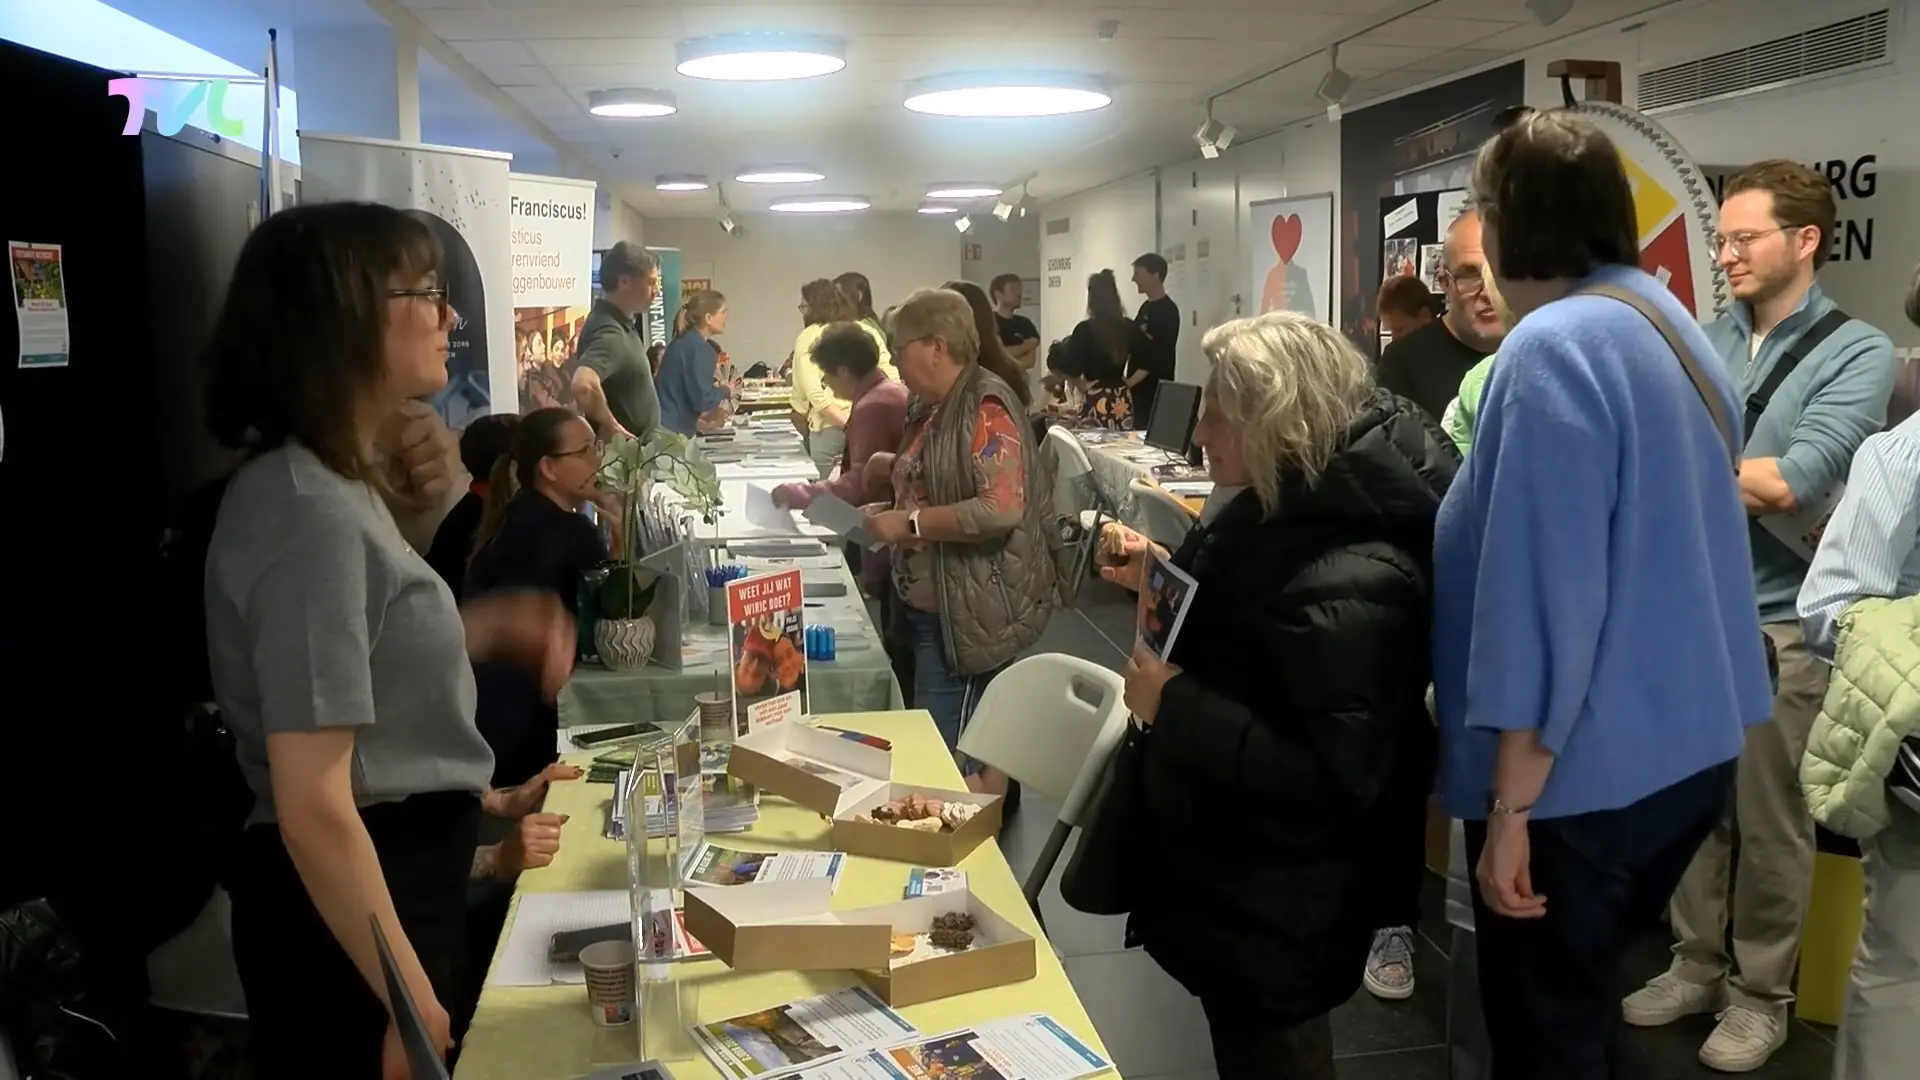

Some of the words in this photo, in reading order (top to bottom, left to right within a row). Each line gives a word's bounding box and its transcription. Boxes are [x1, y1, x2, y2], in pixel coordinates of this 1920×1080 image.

[510, 196, 586, 220] Franciscus!
[738, 584, 760, 601] WEET
[762, 581, 774, 596] JIJ
[775, 577, 792, 592] WAT
[743, 599, 768, 617] WIRIC
[769, 592, 791, 610] DOET?
